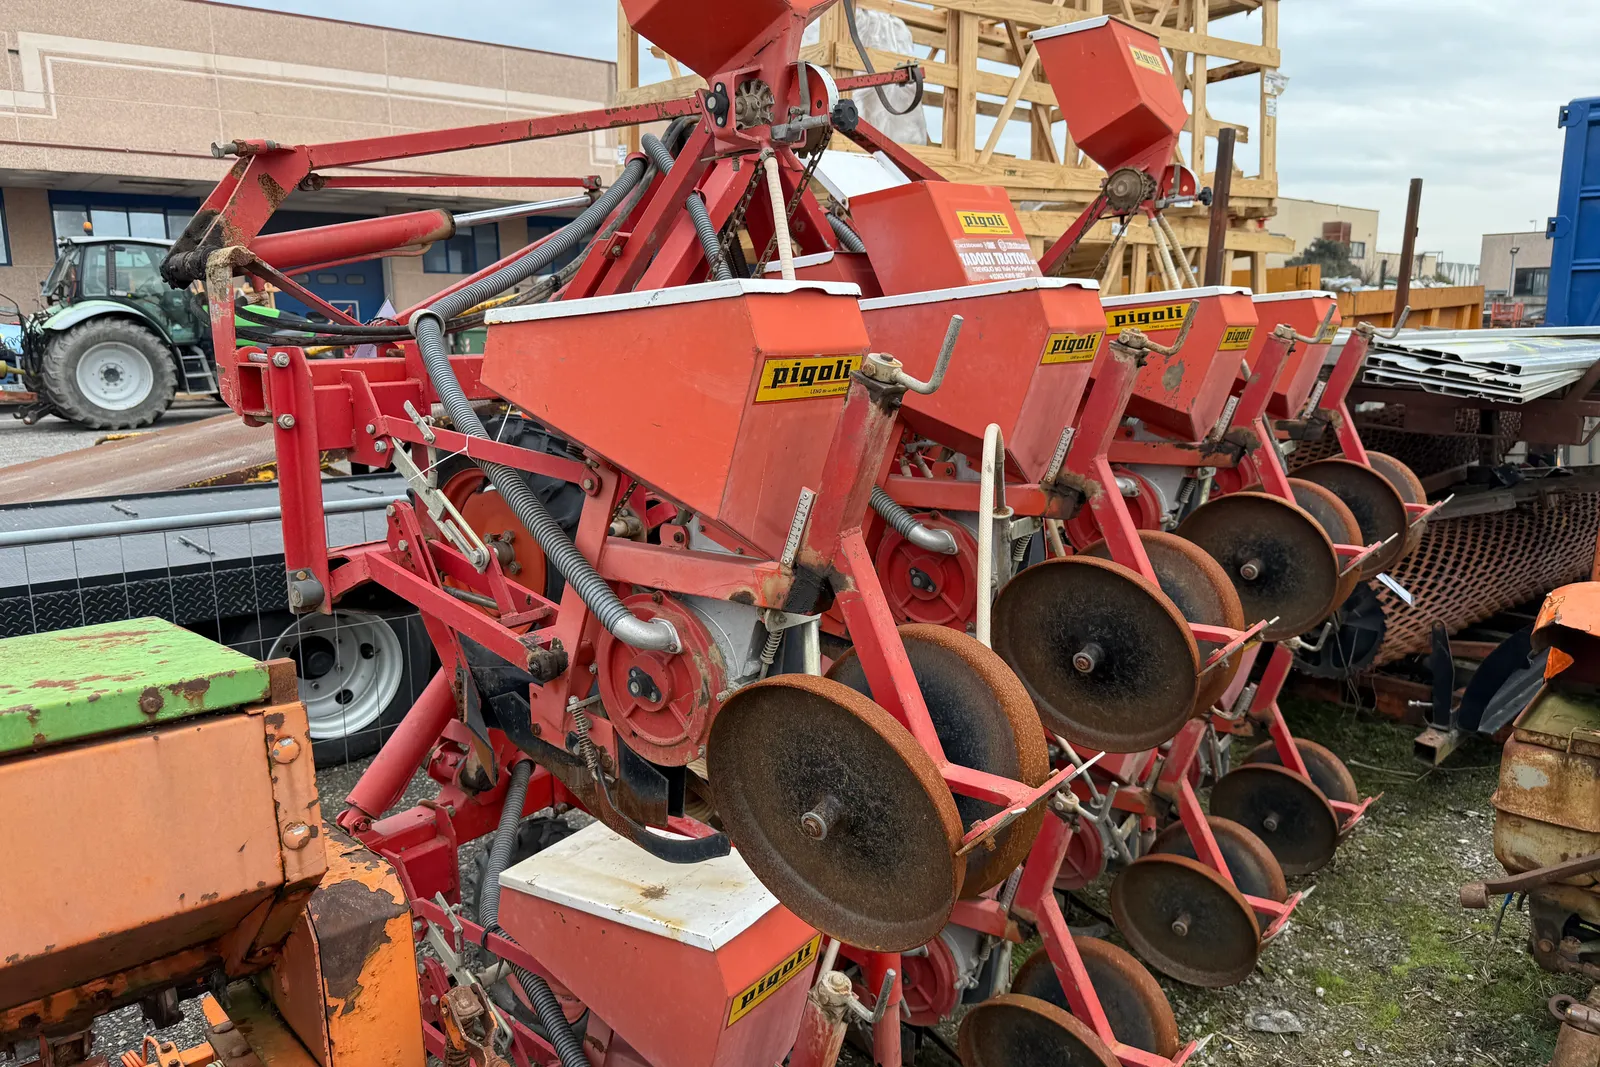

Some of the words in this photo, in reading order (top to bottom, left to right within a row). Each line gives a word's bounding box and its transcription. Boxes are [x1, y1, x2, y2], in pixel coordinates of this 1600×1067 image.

[963, 213, 1005, 227] pigoli
[993, 252, 1032, 265] TRATTORI
[1113, 306, 1183, 327] pigoli
[1050, 334, 1096, 354] pigoli
[1225, 329, 1253, 344] pigoli
[771, 360, 852, 389] pigoli
[741, 942, 812, 1010] pigoli
